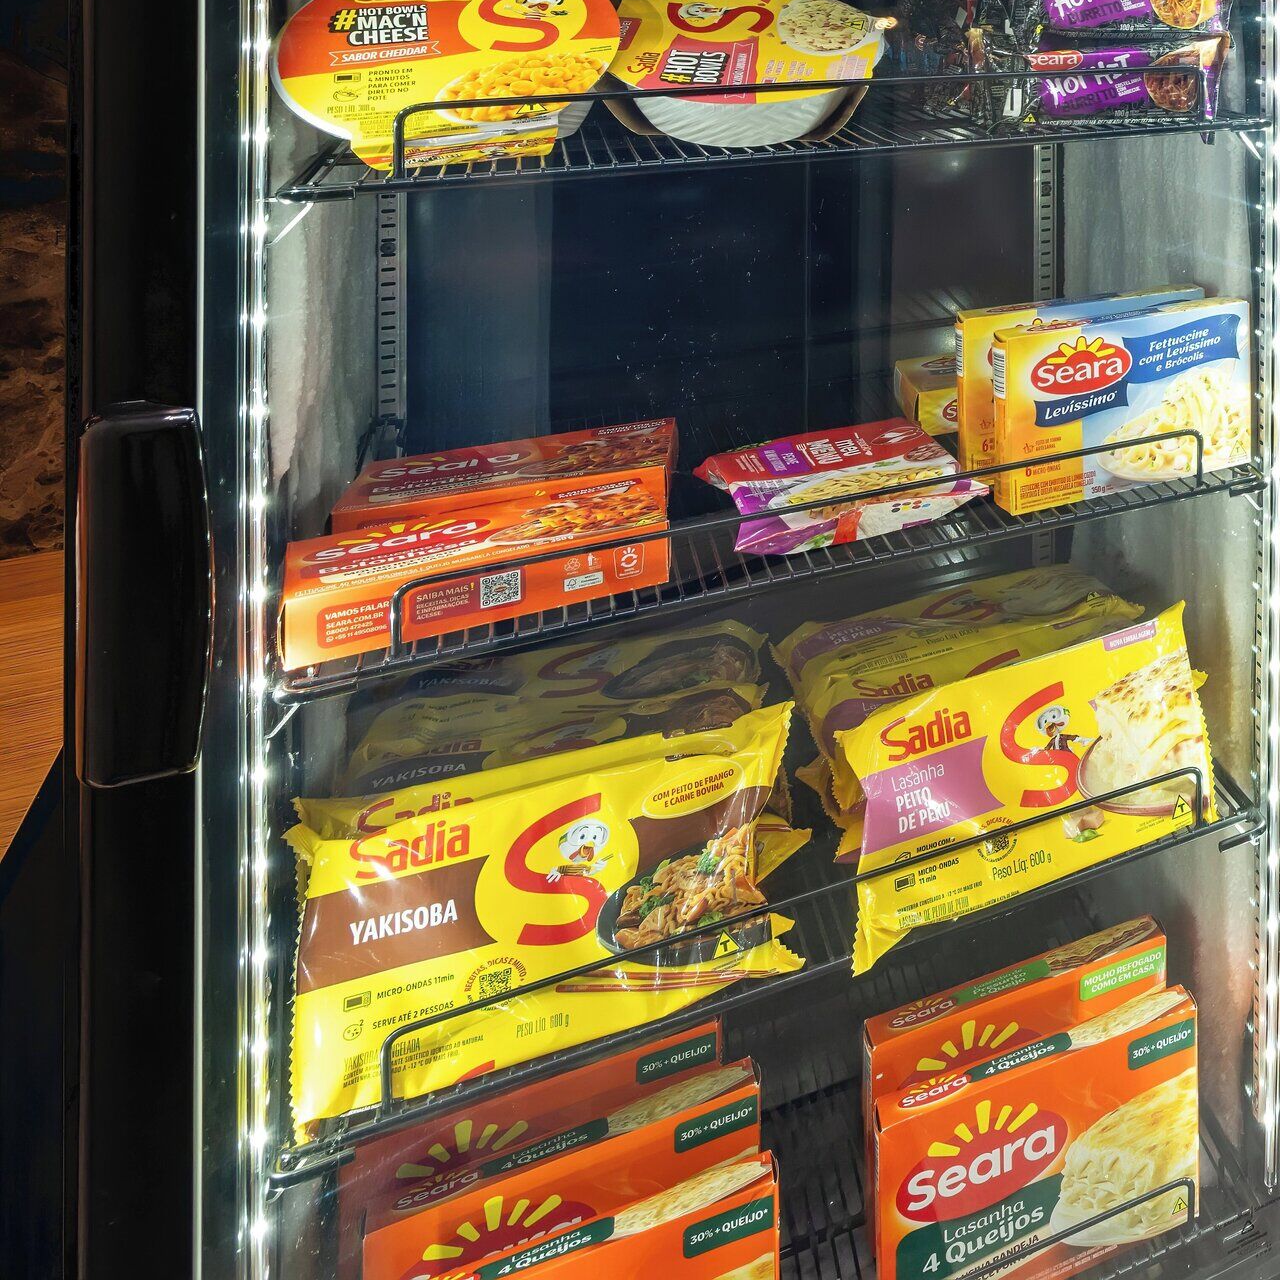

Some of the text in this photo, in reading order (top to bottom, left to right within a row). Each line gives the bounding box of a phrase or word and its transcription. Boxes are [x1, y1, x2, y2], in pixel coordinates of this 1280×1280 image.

[357, 12, 428, 30] MAC'N
[359, 8, 383, 16] HOT
[386, 5, 427, 14] BOWLS
[349, 28, 429, 46] CHEESE
[341, 46, 427, 63] SABOR CHEDDAR
[700, 51, 727, 84] BOWLS
[1028, 53, 1079, 67] Seara
[367, 80, 416, 90] PARA COMER
[368, 68, 397, 76] PRONTO
[376, 74, 410, 82] MINUTOS
[367, 86, 409, 96] DIRETO NO
[1138, 334, 1221, 367] com Levíssimo
[1149, 326, 1210, 351] Fettuccine
[1036, 354, 1124, 387] Seara
[1164, 350, 1204, 370] Brócolis
[1045, 390, 1117, 420] Levíssimo
[315, 521, 478, 561] Seara
[318, 539, 479, 574] Bolonhesa
[415, 584, 469, 602] SAIBA MAIS
[325, 601, 390, 621] VAMOS FALAR
[325, 611, 384, 630] SEARA.COM.BR
[852, 672, 935, 698] Sadia
[880, 708, 973, 763] Sadia
[372, 763, 467, 789] YAKISOBA
[652, 768, 734, 802] COM PEITO DE FRANGO
[891, 762, 945, 792] Lasanha
[670, 792, 695, 806] CARNE
[696, 782, 724, 797] BOVINA
[896, 786, 933, 813] PEITO
[898, 815, 916, 834] DE
[350, 819, 471, 880] Sadia
[916, 837, 951, 853] MOLHO COM
[918, 857, 960, 876] MICRO-ONDAS
[992, 866, 1012, 880] Peso
[1029, 850, 1045, 868] 600
[349, 898, 458, 946] YAKISOBA
[1083, 951, 1163, 987] MOLHO REFOGADO
[1091, 963, 1155, 993] COMO EM CASA
[376, 980, 433, 1000] MICRO-ONDAS
[372, 1016, 397, 1030] SERVE
[398, 1010, 412, 1022] ATÉ
[420, 1000, 454, 1017] PESSOAS
[992, 1040, 1044, 1066] Lasanha
[996, 1043, 1056, 1072] Queijos
[901, 1074, 968, 1107] Seara
[907, 1125, 1056, 1212] Seara
[943, 1200, 1025, 1243] Lasanha
[923, 1252, 941, 1273] 4
[945, 1206, 1044, 1264] Queijos
